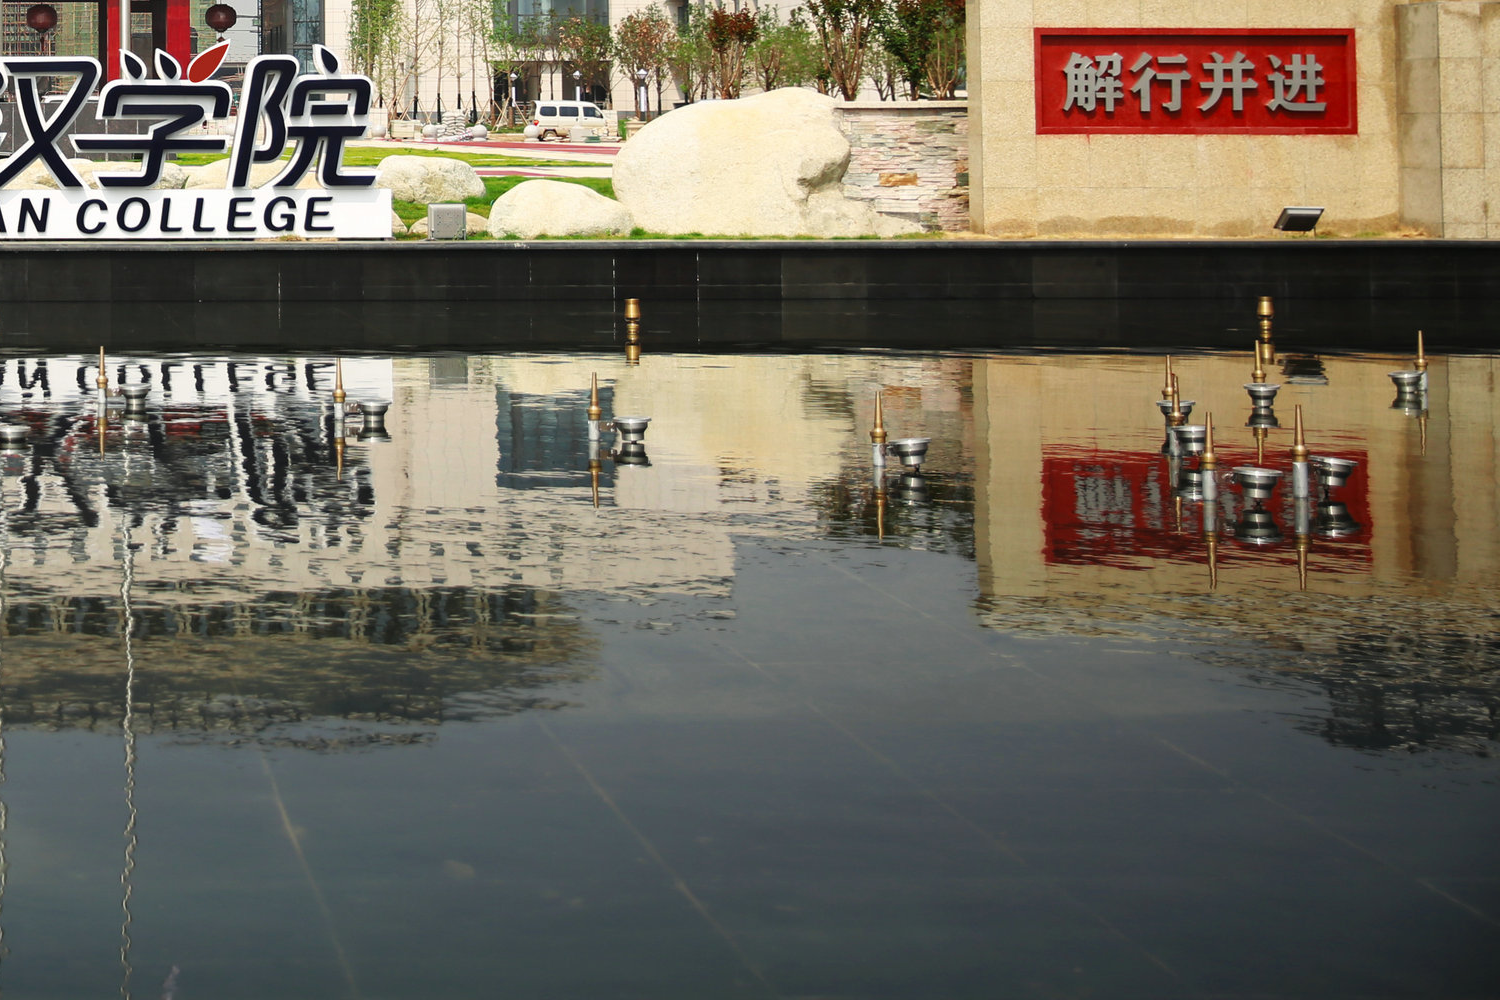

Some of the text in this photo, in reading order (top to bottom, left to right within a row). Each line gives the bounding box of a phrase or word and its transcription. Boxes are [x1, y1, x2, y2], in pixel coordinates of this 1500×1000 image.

[1062, 51, 1327, 113] 解行并进
[75, 195, 336, 233] COLLEGE
